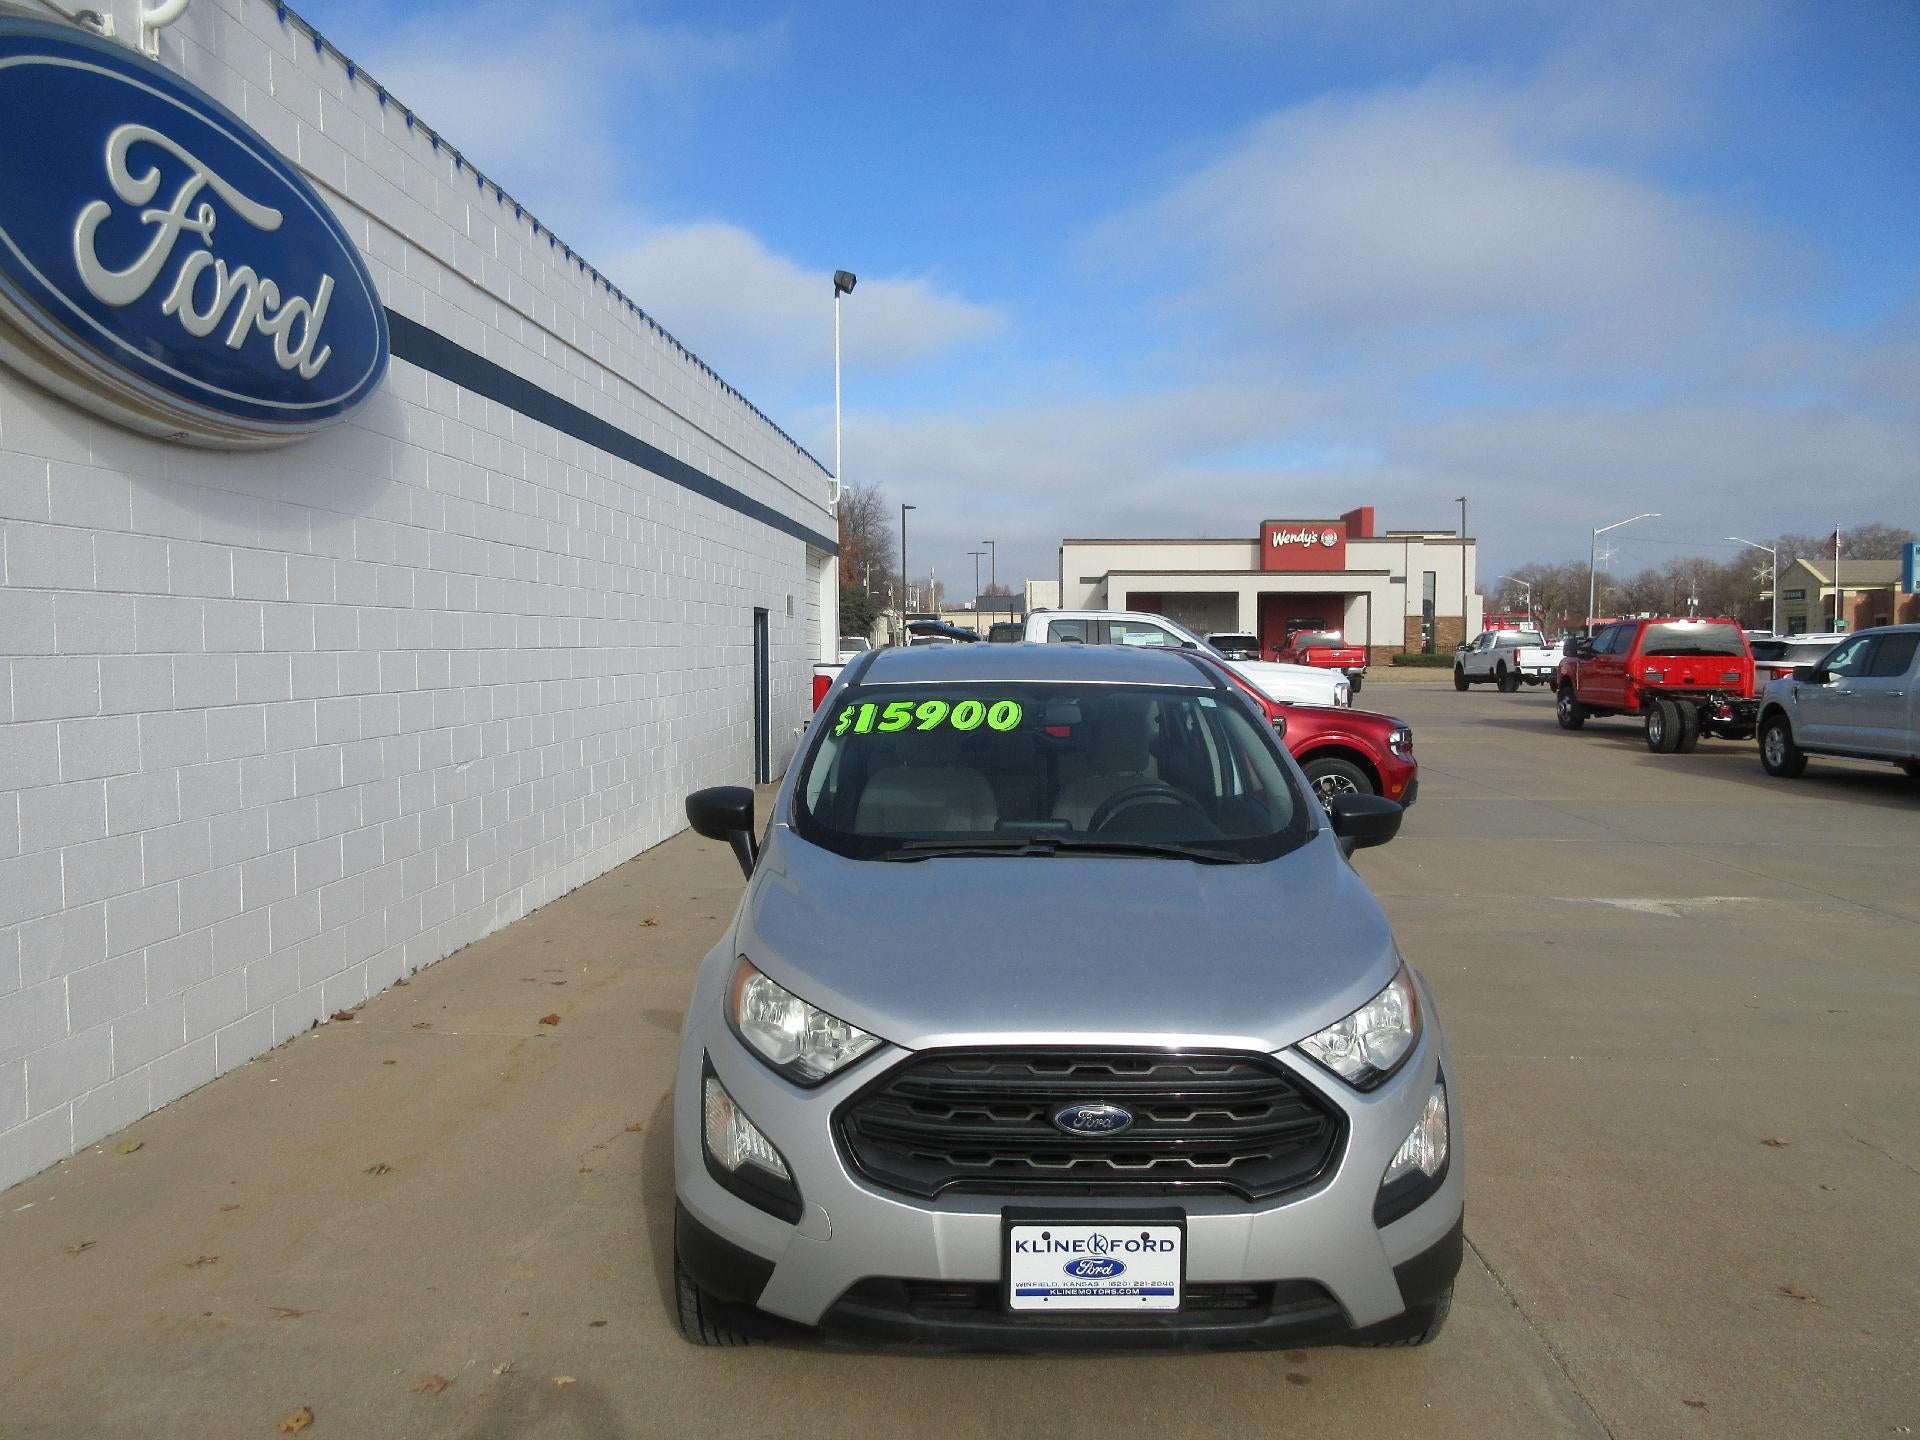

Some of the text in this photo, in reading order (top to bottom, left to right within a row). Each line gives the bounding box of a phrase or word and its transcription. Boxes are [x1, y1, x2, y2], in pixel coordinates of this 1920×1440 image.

[73, 123, 334, 381] Ford
[1273, 528, 1318, 547] Wendy's
[835, 700, 1023, 736] $15900
[1073, 1110, 1115, 1128] Ford
[1015, 1239, 1086, 1253] KLINE
[1110, 1239, 1175, 1253] FORD
[1076, 1259, 1113, 1275] Ford
[1049, 1288, 1140, 1296] KLINEMOTORS.COM
